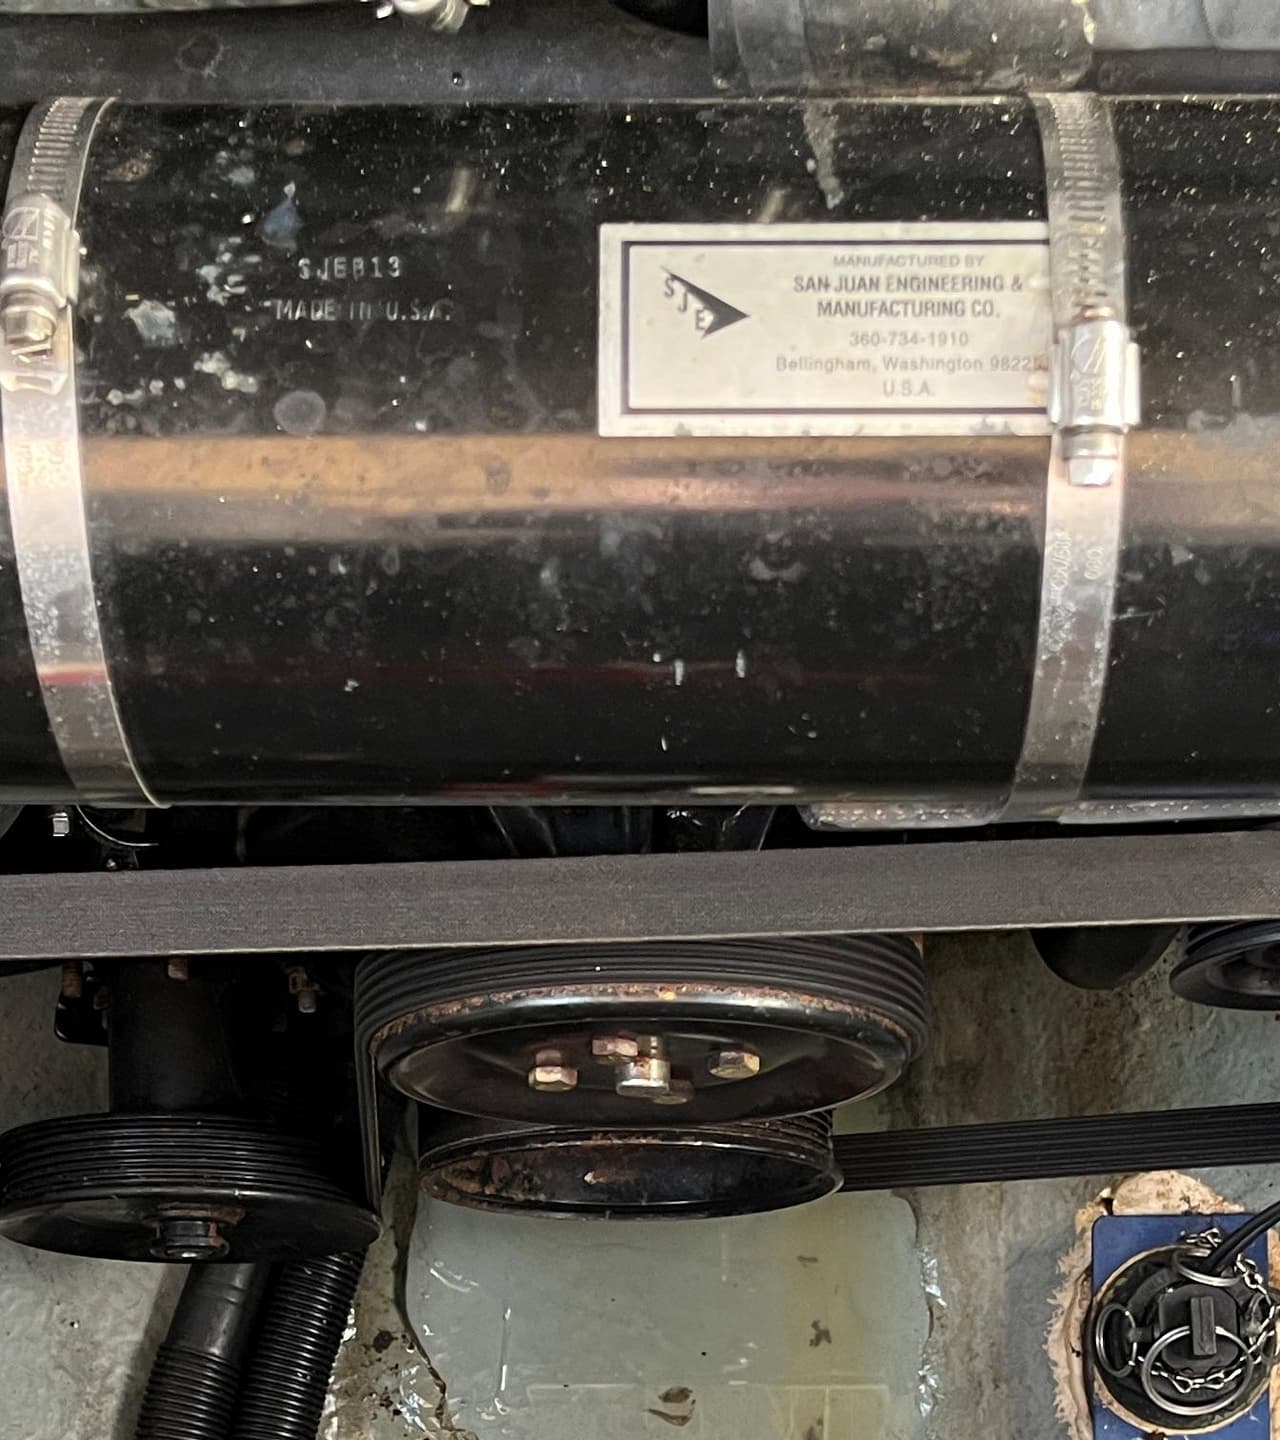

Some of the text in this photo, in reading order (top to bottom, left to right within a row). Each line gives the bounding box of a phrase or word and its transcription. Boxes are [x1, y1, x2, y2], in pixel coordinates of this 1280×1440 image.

[833, 255, 985, 267] MANUFACTURED BY
[834, 275, 880, 292] JUAN
[885, 275, 1004, 292] ENGINEERING
[1011, 276, 1023, 292] &
[275, 298, 337, 321] MADE
[817, 300, 1000, 318] MANUFACTURING CO.
[849, 331, 969, 347] 360-734-1910
[776, 356, 876, 374] Bellingham,
[882, 357, 983, 374] Washington
[882, 379, 936, 398] U.S.A.
